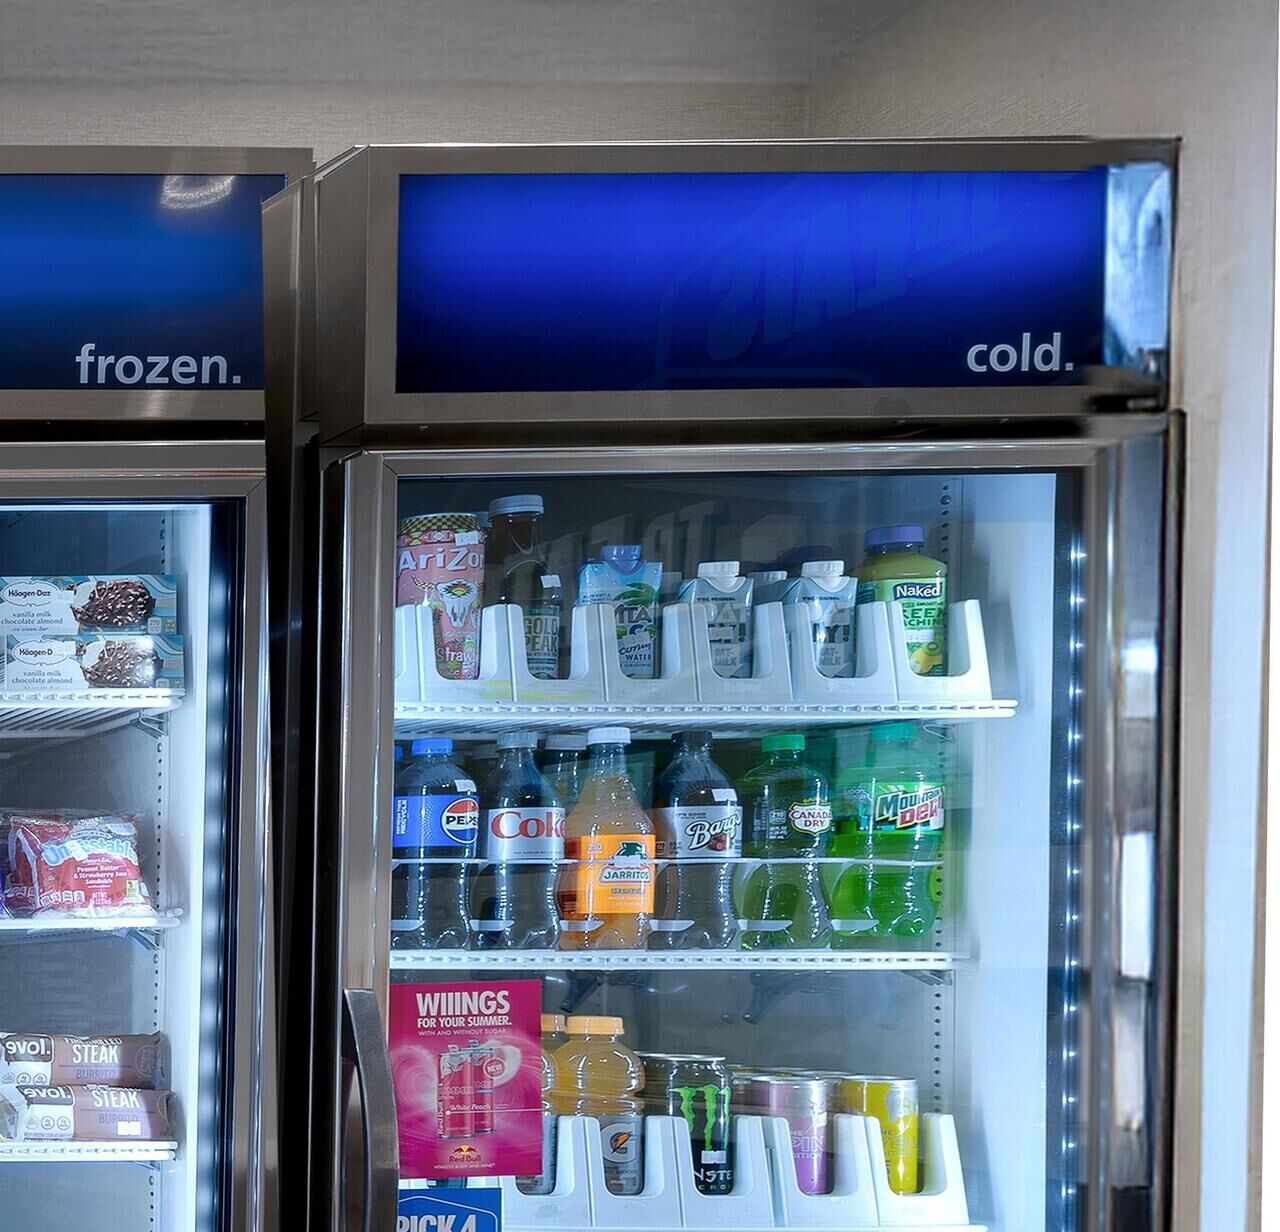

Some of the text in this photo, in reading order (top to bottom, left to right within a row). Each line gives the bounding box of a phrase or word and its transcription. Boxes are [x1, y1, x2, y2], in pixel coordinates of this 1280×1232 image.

[966, 333, 1075, 373] cold.
[76, 343, 242, 387] frozen.
[896, 583, 940, 599] Naked
[1, 617, 36, 625] chocolate
[524, 617, 559, 634] GOLD
[790, 810, 832, 820] CANADA
[803, 819, 824, 828] DRY
[603, 869, 650, 881] JARRITOS
[416, 990, 511, 1017] WIIINGS
[417, 1015, 512, 1028] FOR YOUR SUMMER.
[72, 1044, 119, 1064] STEAK
[93, 1090, 141, 1109] STEAK
[449, 1155, 465, 1163] Red
